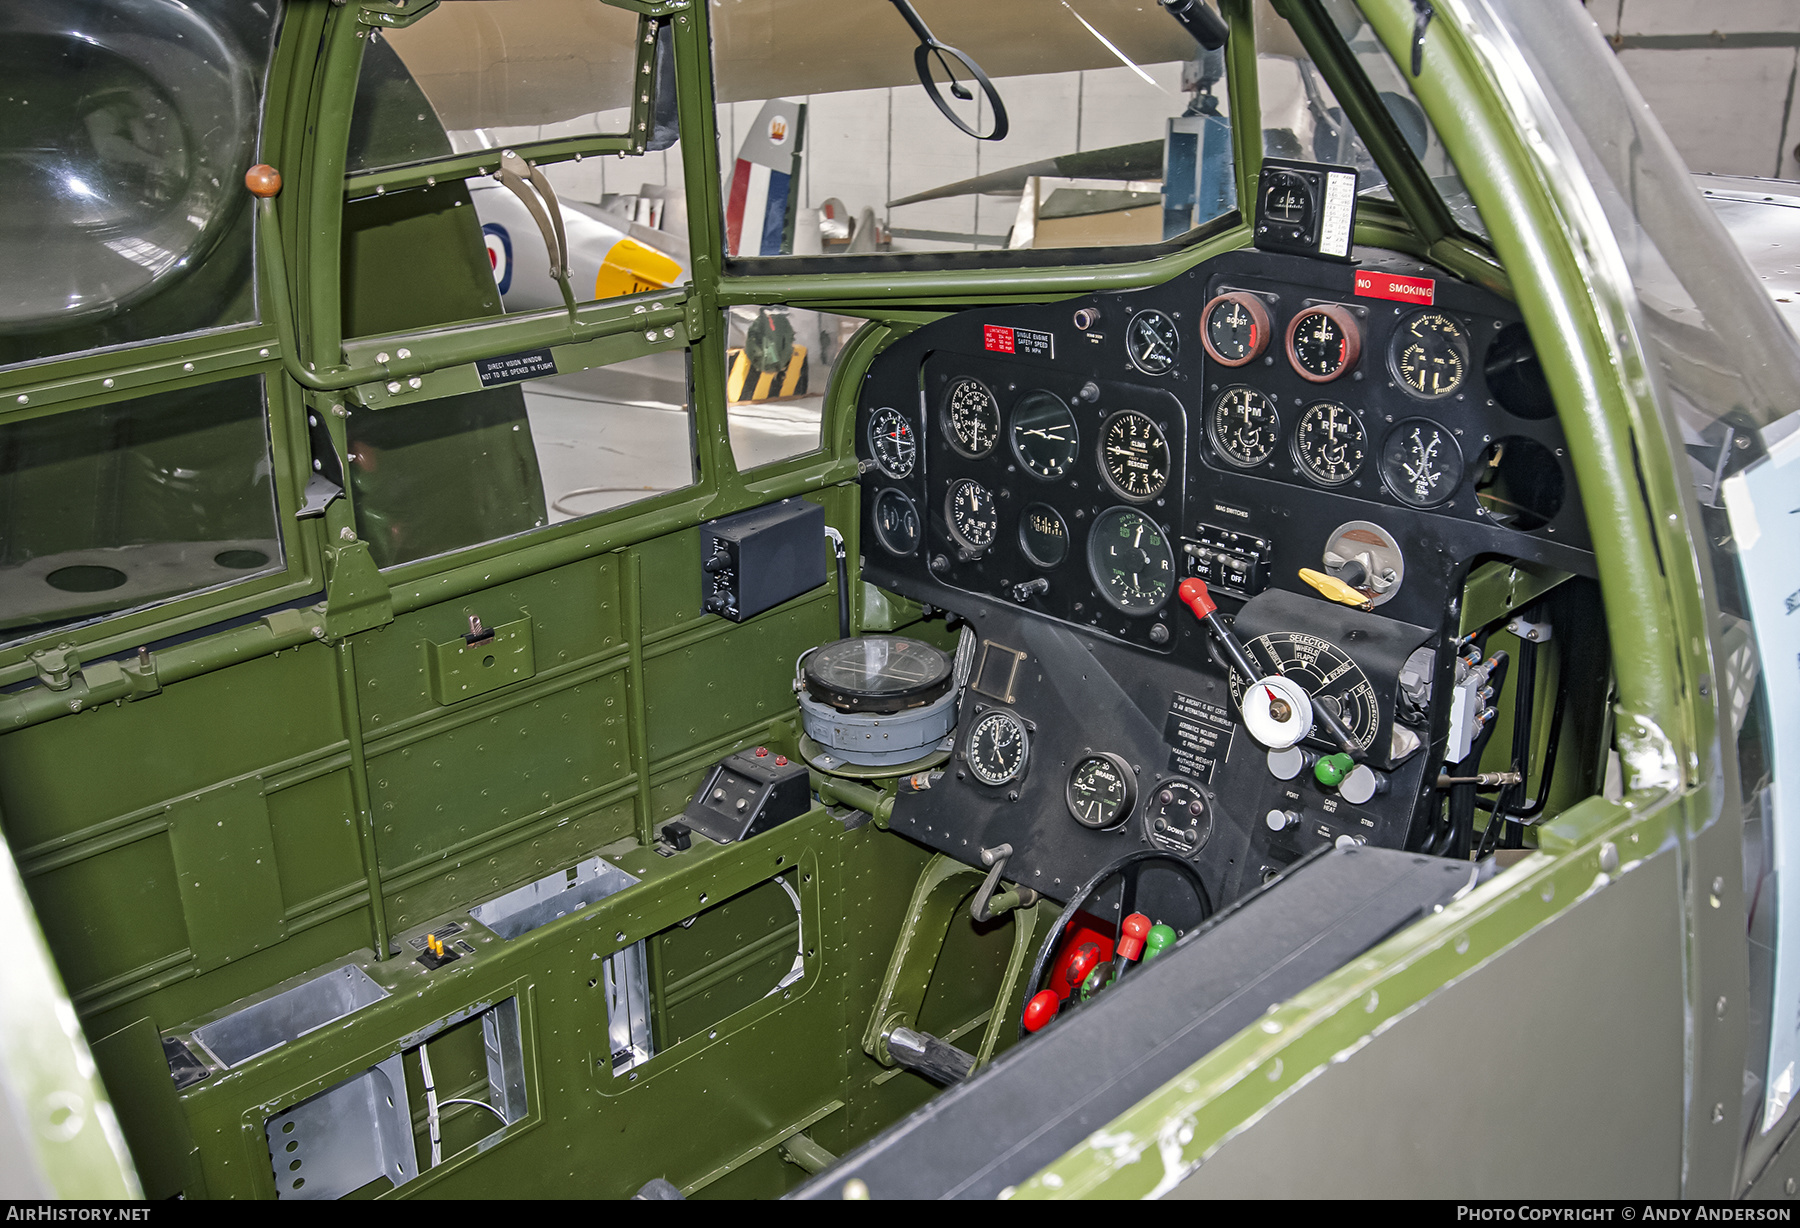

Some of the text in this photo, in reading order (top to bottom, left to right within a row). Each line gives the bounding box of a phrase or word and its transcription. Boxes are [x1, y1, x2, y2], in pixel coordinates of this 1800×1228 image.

[1358, 279, 1432, 297] NO SMOKING
[1226, 316, 1248, 325] BOOST
[1017, 331, 1031, 339] SINGLE
[1018, 338, 1048, 349] SAFETY SPEED
[1238, 344, 1244, 353] 8
[487, 355, 542, 370] DIRECT VISION WINDOW
[1321, 360, 1327, 368] 8
[510, 366, 529, 376] OPENED
[537, 362, 553, 370] FLIGHT
[1234, 396, 1238, 404] 9
[1224, 408, 1228, 416] 8
[1237, 405, 1262, 416] RPM
[1270, 416, 1275, 424] 2
[1318, 411, 1322, 420] 9
[1130, 426, 1136, 435] 2
[1307, 423, 1312, 432] 8
[1322, 420, 1348, 433] RPM
[1143, 429, 1149, 438] 3
[1270, 434, 1275, 442] 3
[1356, 432, 1362, 440] 2
[1130, 440, 1146, 449] CLIMB
[1153, 438, 1159, 448] 4
[1232, 440, 1237, 448] 6
[1306, 442, 1311, 450] 7
[1246, 448, 1251, 456] 5
[1356, 450, 1361, 459] 3
[1127, 460, 1149, 470] DESCENT
[1316, 457, 1321, 465] 6
[1152, 468, 1159, 478] 4
[1331, 465, 1336, 474] 5
[1129, 472, 1136, 481] 2
[1142, 474, 1148, 483] 3
[959, 497, 964, 505] 8
[1215, 504, 1249, 518] MAG SWITCHES
[1055, 520, 1060, 528] 3
[1110, 546, 1117, 556] L
[1161, 560, 1168, 570] R
[1197, 565, 1209, 574] OFF
[1113, 568, 1125, 576] TURN
[1231, 574, 1242, 583] OFF
[1289, 634, 1330, 651] SELECTOR
[1296, 644, 1319, 656] WHEELS
[1297, 652, 1314, 663] FLAPS
[1356, 684, 1366, 693] UP
[1186, 698, 1202, 708] AIRCRAFT
[1184, 706, 1208, 719] INTERNATIONAL
[1179, 721, 1218, 740] AEROBATICS INCLUDING
[1178, 730, 1198, 742] INTENTIONAL
[1187, 741, 1207, 753] PROHIBITED
[1172, 747, 1213, 766] MAXIMUM WEIGHT
[1177, 756, 1205, 771] AUTHORISED
[1095, 770, 1115, 781] BRAKES
[1189, 787, 1201, 798] GEAR
[1286, 790, 1299, 799] PORT
[1324, 799, 1338, 808] CARB
[1161, 807, 1166, 815] L
[1323, 805, 1336, 813] HEAT
[1191, 818, 1198, 826] R
[1360, 818, 1375, 828] STBD
[1167, 825, 1184, 836] DOWN
